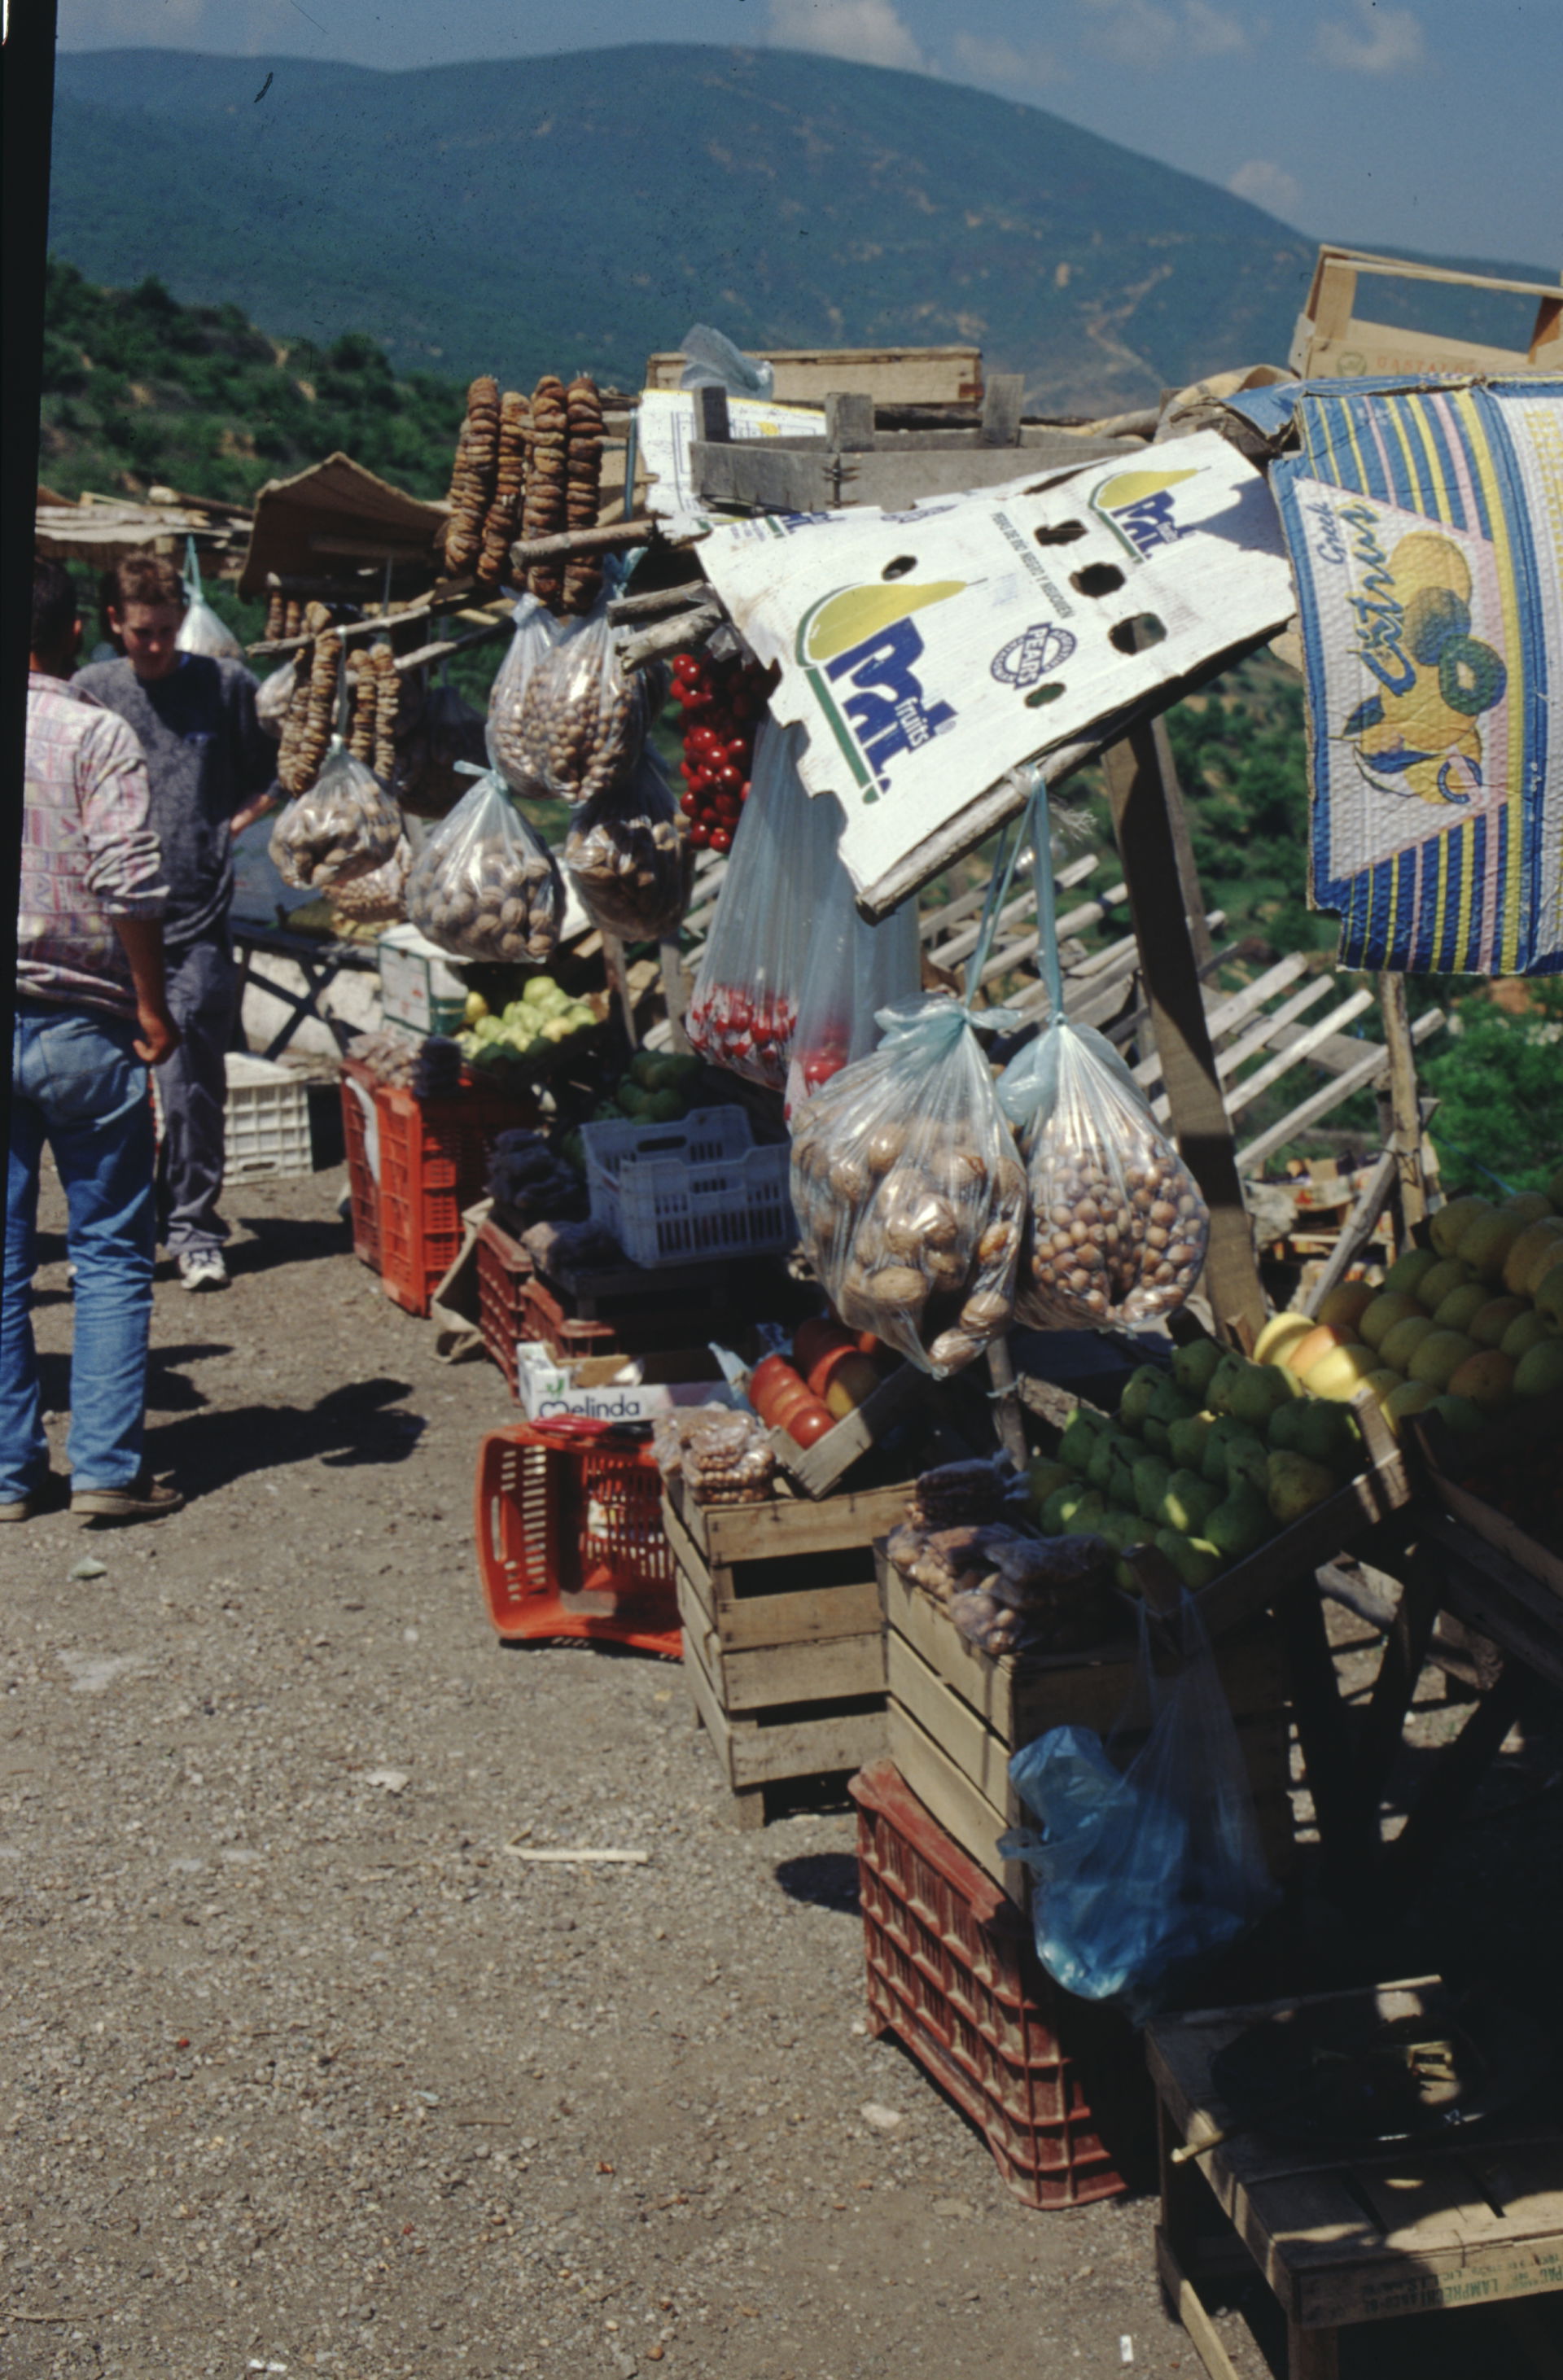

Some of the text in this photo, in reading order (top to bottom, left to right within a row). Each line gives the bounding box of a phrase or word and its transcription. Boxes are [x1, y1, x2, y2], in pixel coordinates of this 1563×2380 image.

[1306, 501, 1347, 564] Greek
[1339, 502, 1416, 698] Citrus
[1016, 628, 1049, 684] PEARS
[895, 695, 930, 747] fruits
